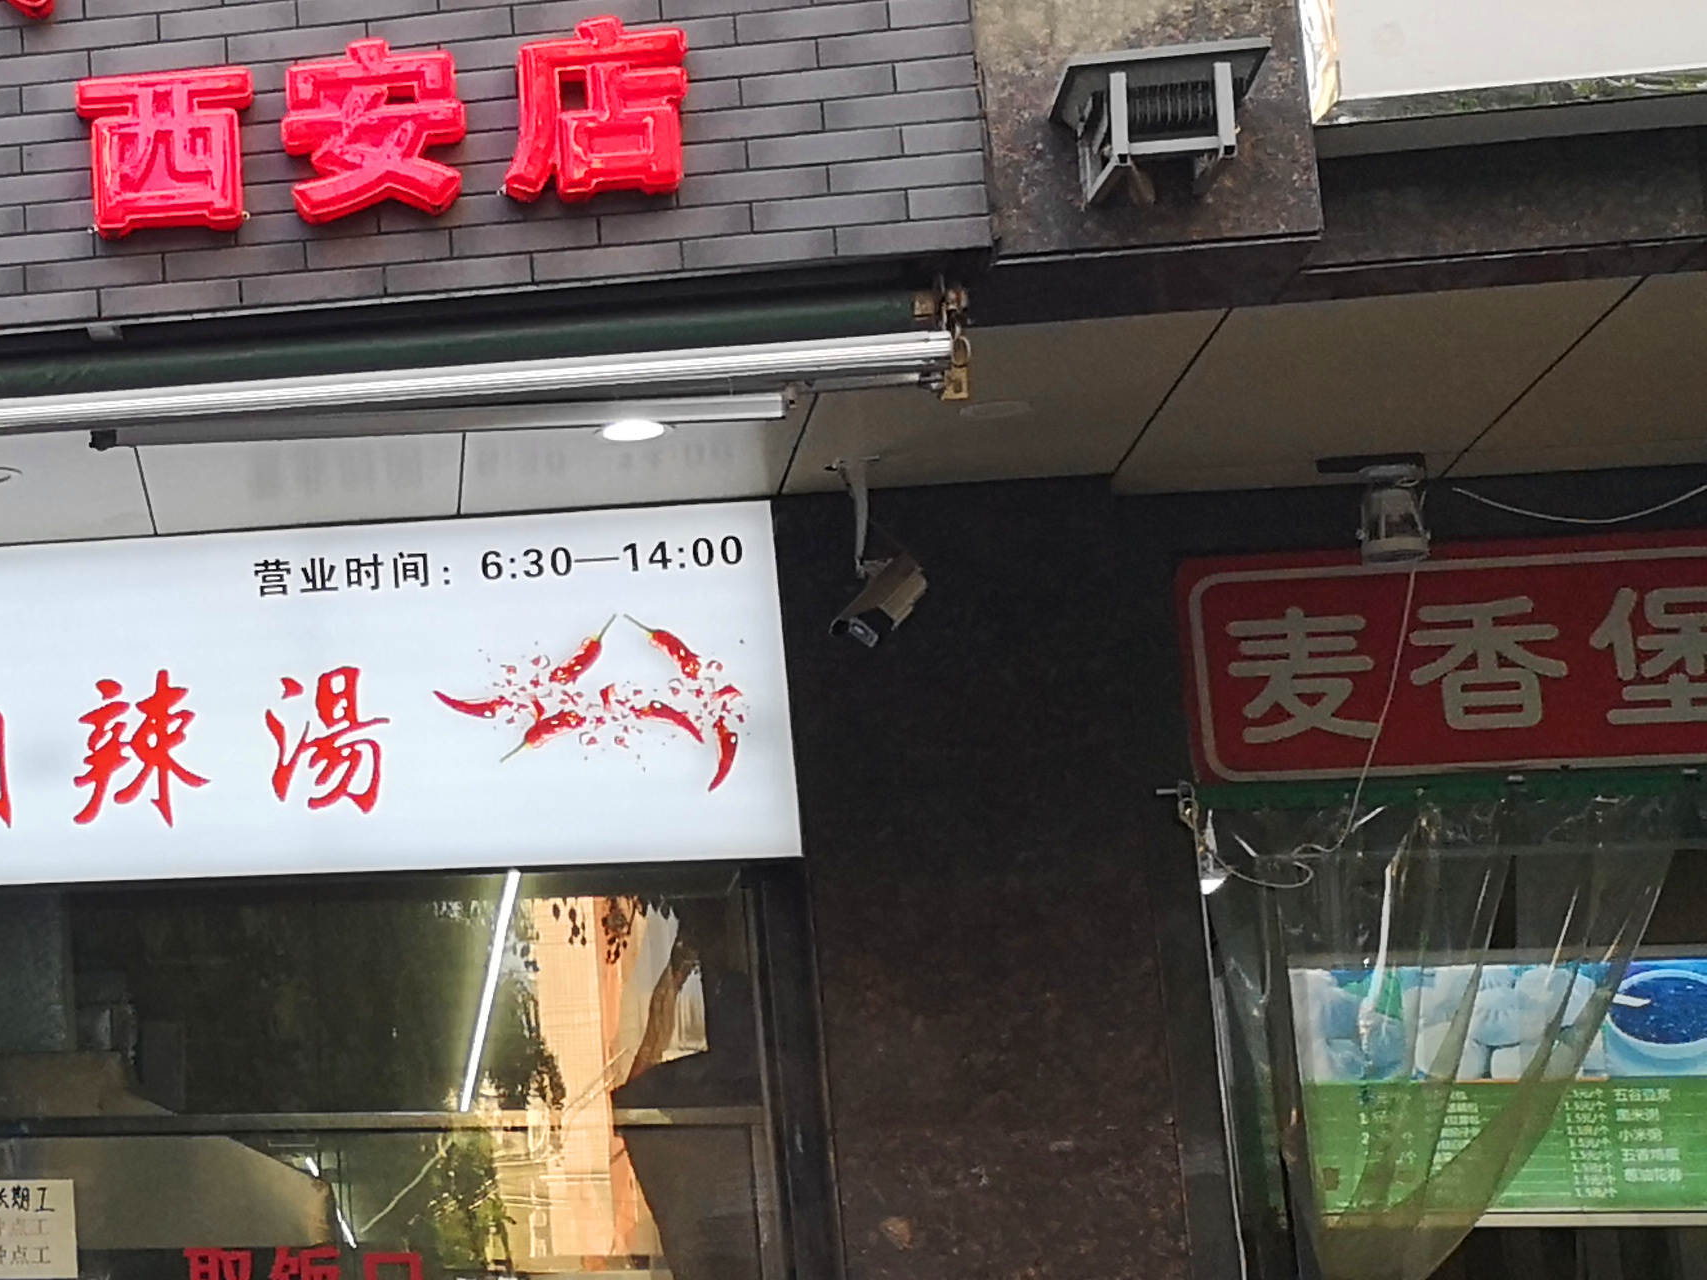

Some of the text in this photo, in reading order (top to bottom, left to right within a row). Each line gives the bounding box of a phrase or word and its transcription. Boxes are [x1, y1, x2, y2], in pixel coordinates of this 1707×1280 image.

[75, 16, 690, 240] 西安店
[1225, 584, 1707, 746] 麦香堡
